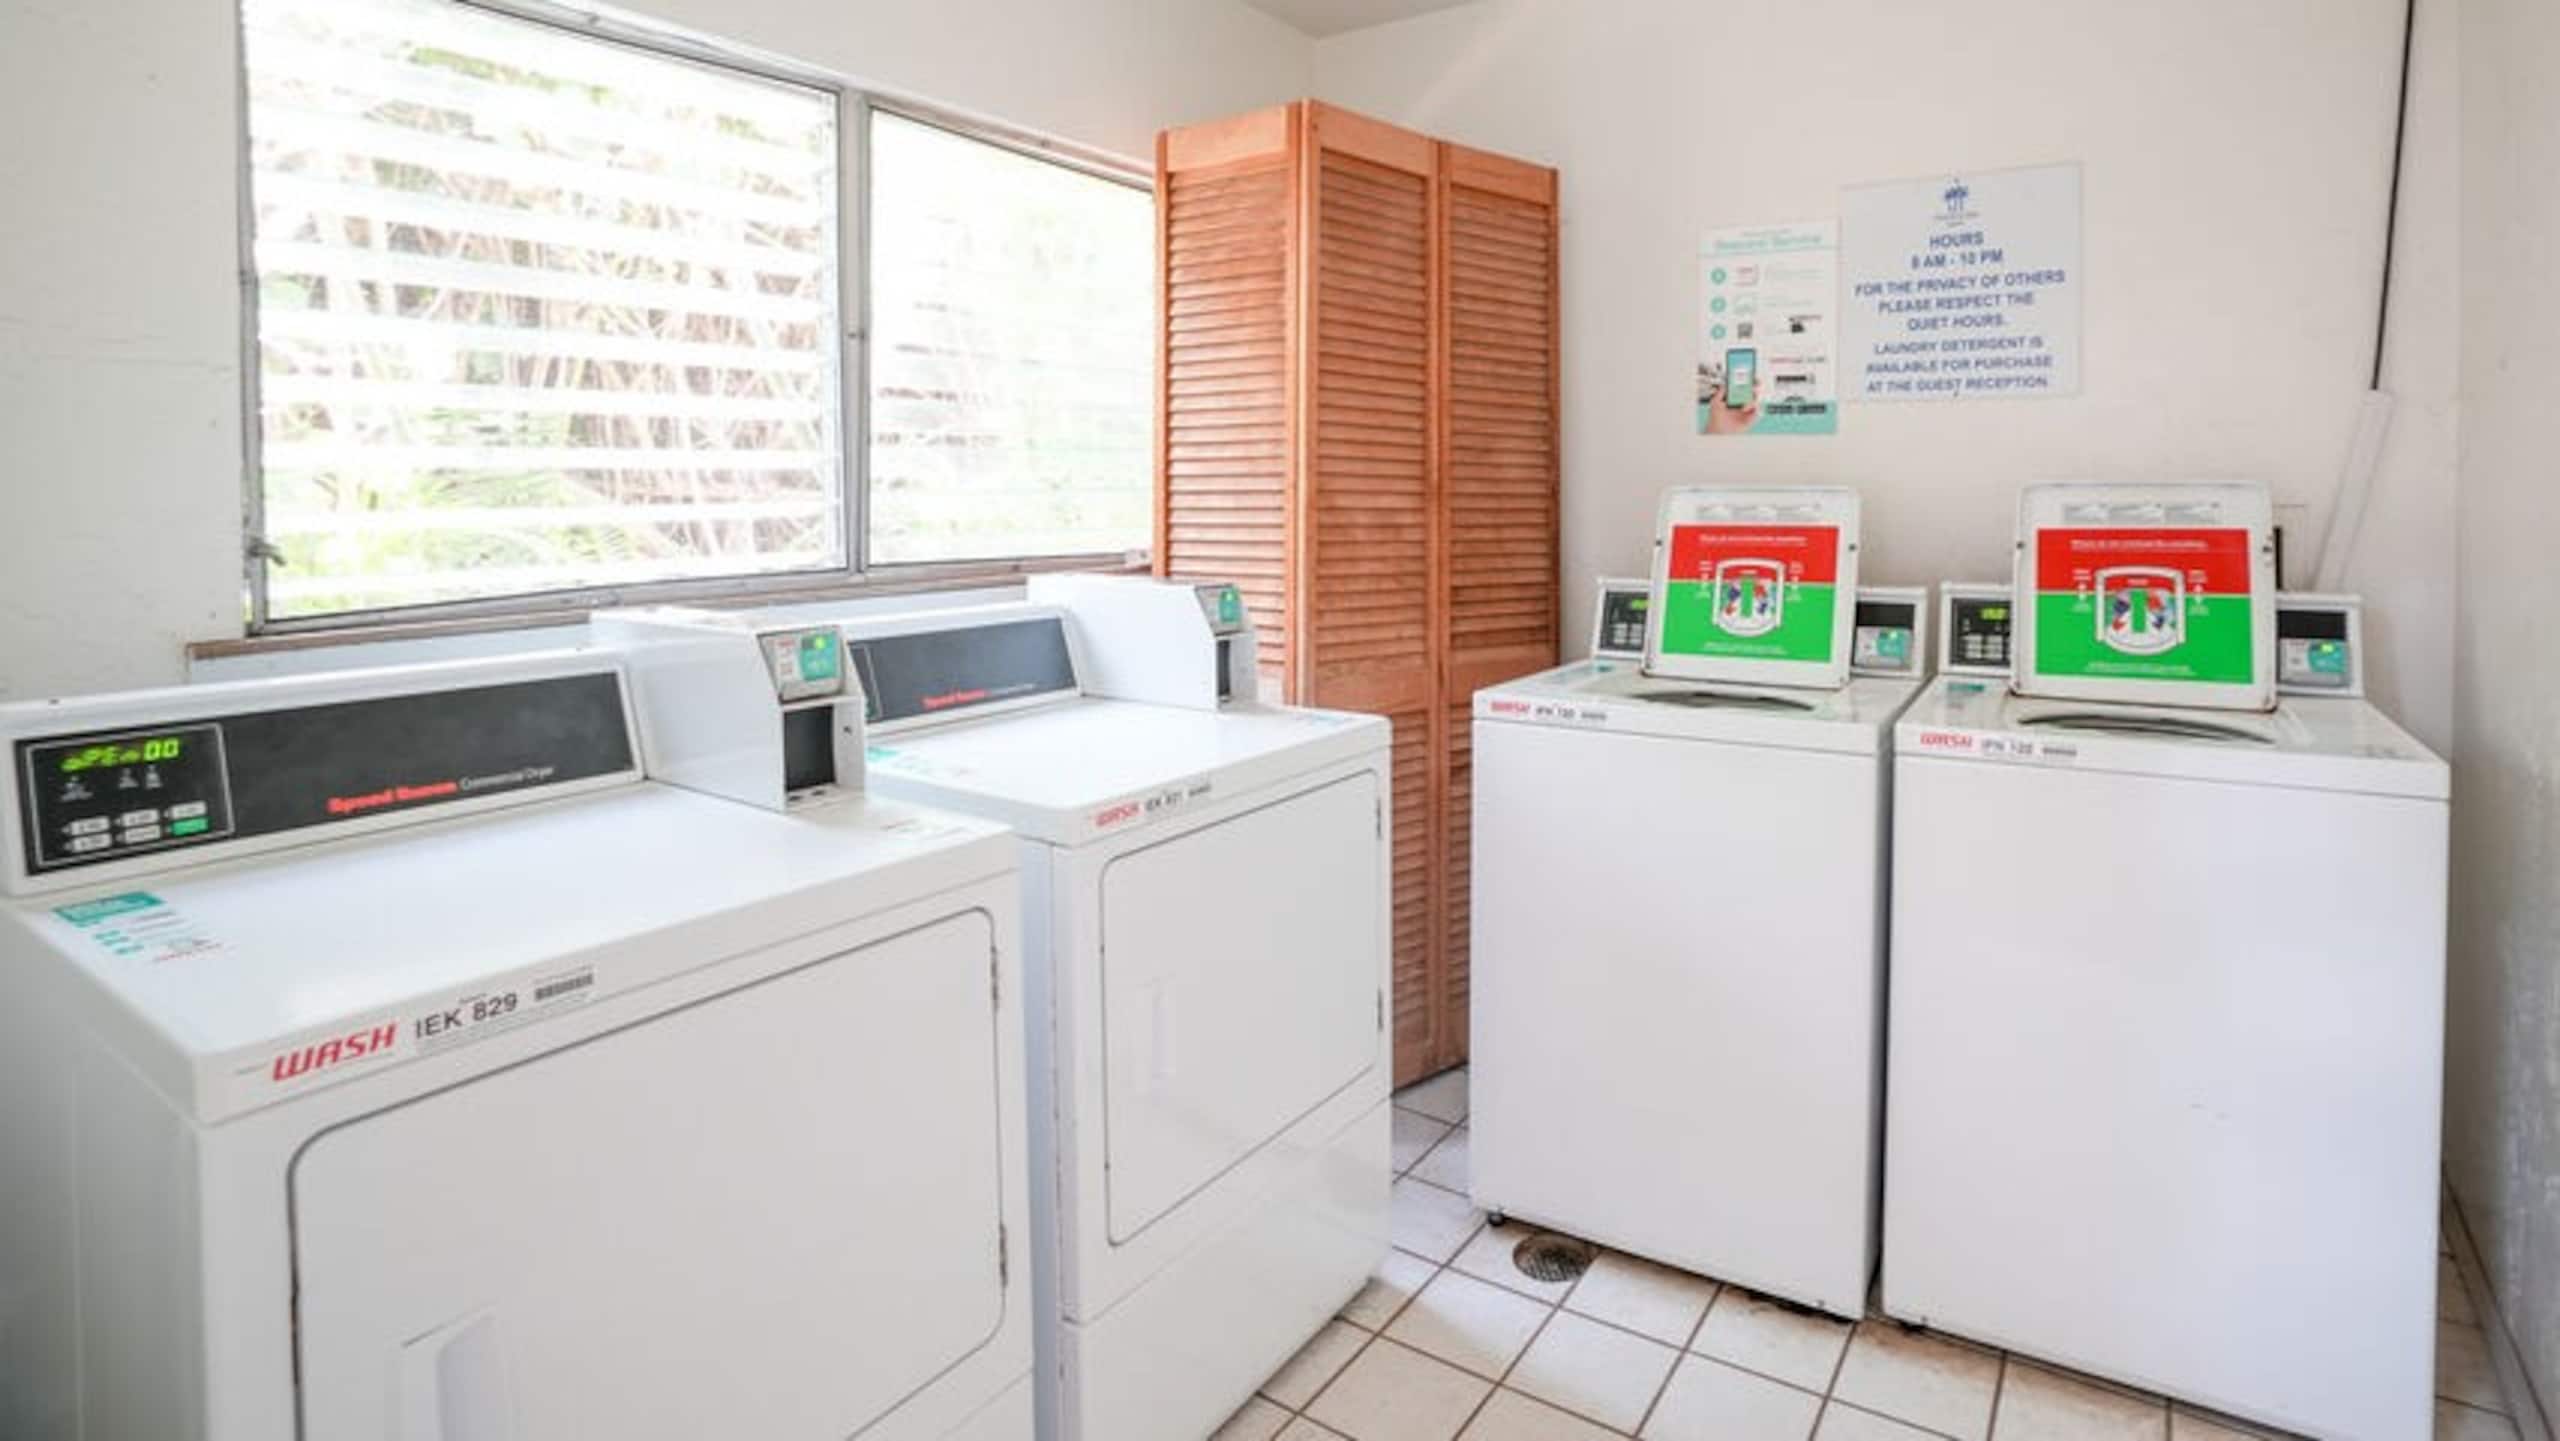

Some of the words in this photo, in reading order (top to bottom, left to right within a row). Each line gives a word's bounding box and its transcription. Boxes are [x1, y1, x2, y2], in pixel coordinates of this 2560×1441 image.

[1928, 230, 1984, 248] HOURS
[1911, 254, 1920, 270] 8
[1923, 253, 1946, 268] AM
[1959, 251, 1976, 266] 10
[1980, 248, 2003, 265] PM
[1855, 281, 1882, 297] FOR
[1886, 279, 1912, 294] THE
[1917, 275, 1977, 293] PRIVACY
[1980, 273, 2001, 289] OF
[2004, 269, 2065, 286] OTHERS
[1878, 296, 1932, 314] PLEASE
[1935, 293, 2001, 310] RESPECT
[2005, 290, 2034, 306] THE
[1907, 316, 1949, 332] QUIET
[1875, 340, 1938, 356] LAUNDRY
[1941, 336, 2025, 353] DETERGENT
[2029, 336, 2043, 350] IS
[1867, 358, 1938, 375] AVAILABLE
[1942, 357, 1970, 372] FOR
[1974, 354, 2053, 370] PURCHASE
[1867, 379, 1885, 394] AT
[1886, 379, 1912, 392] THE
[1917, 377, 1962, 392] GUEST
[271, 1022, 398, 1081] WASH
[415, 1008, 464, 1039] IEK
[471, 992, 518, 1022] 829
